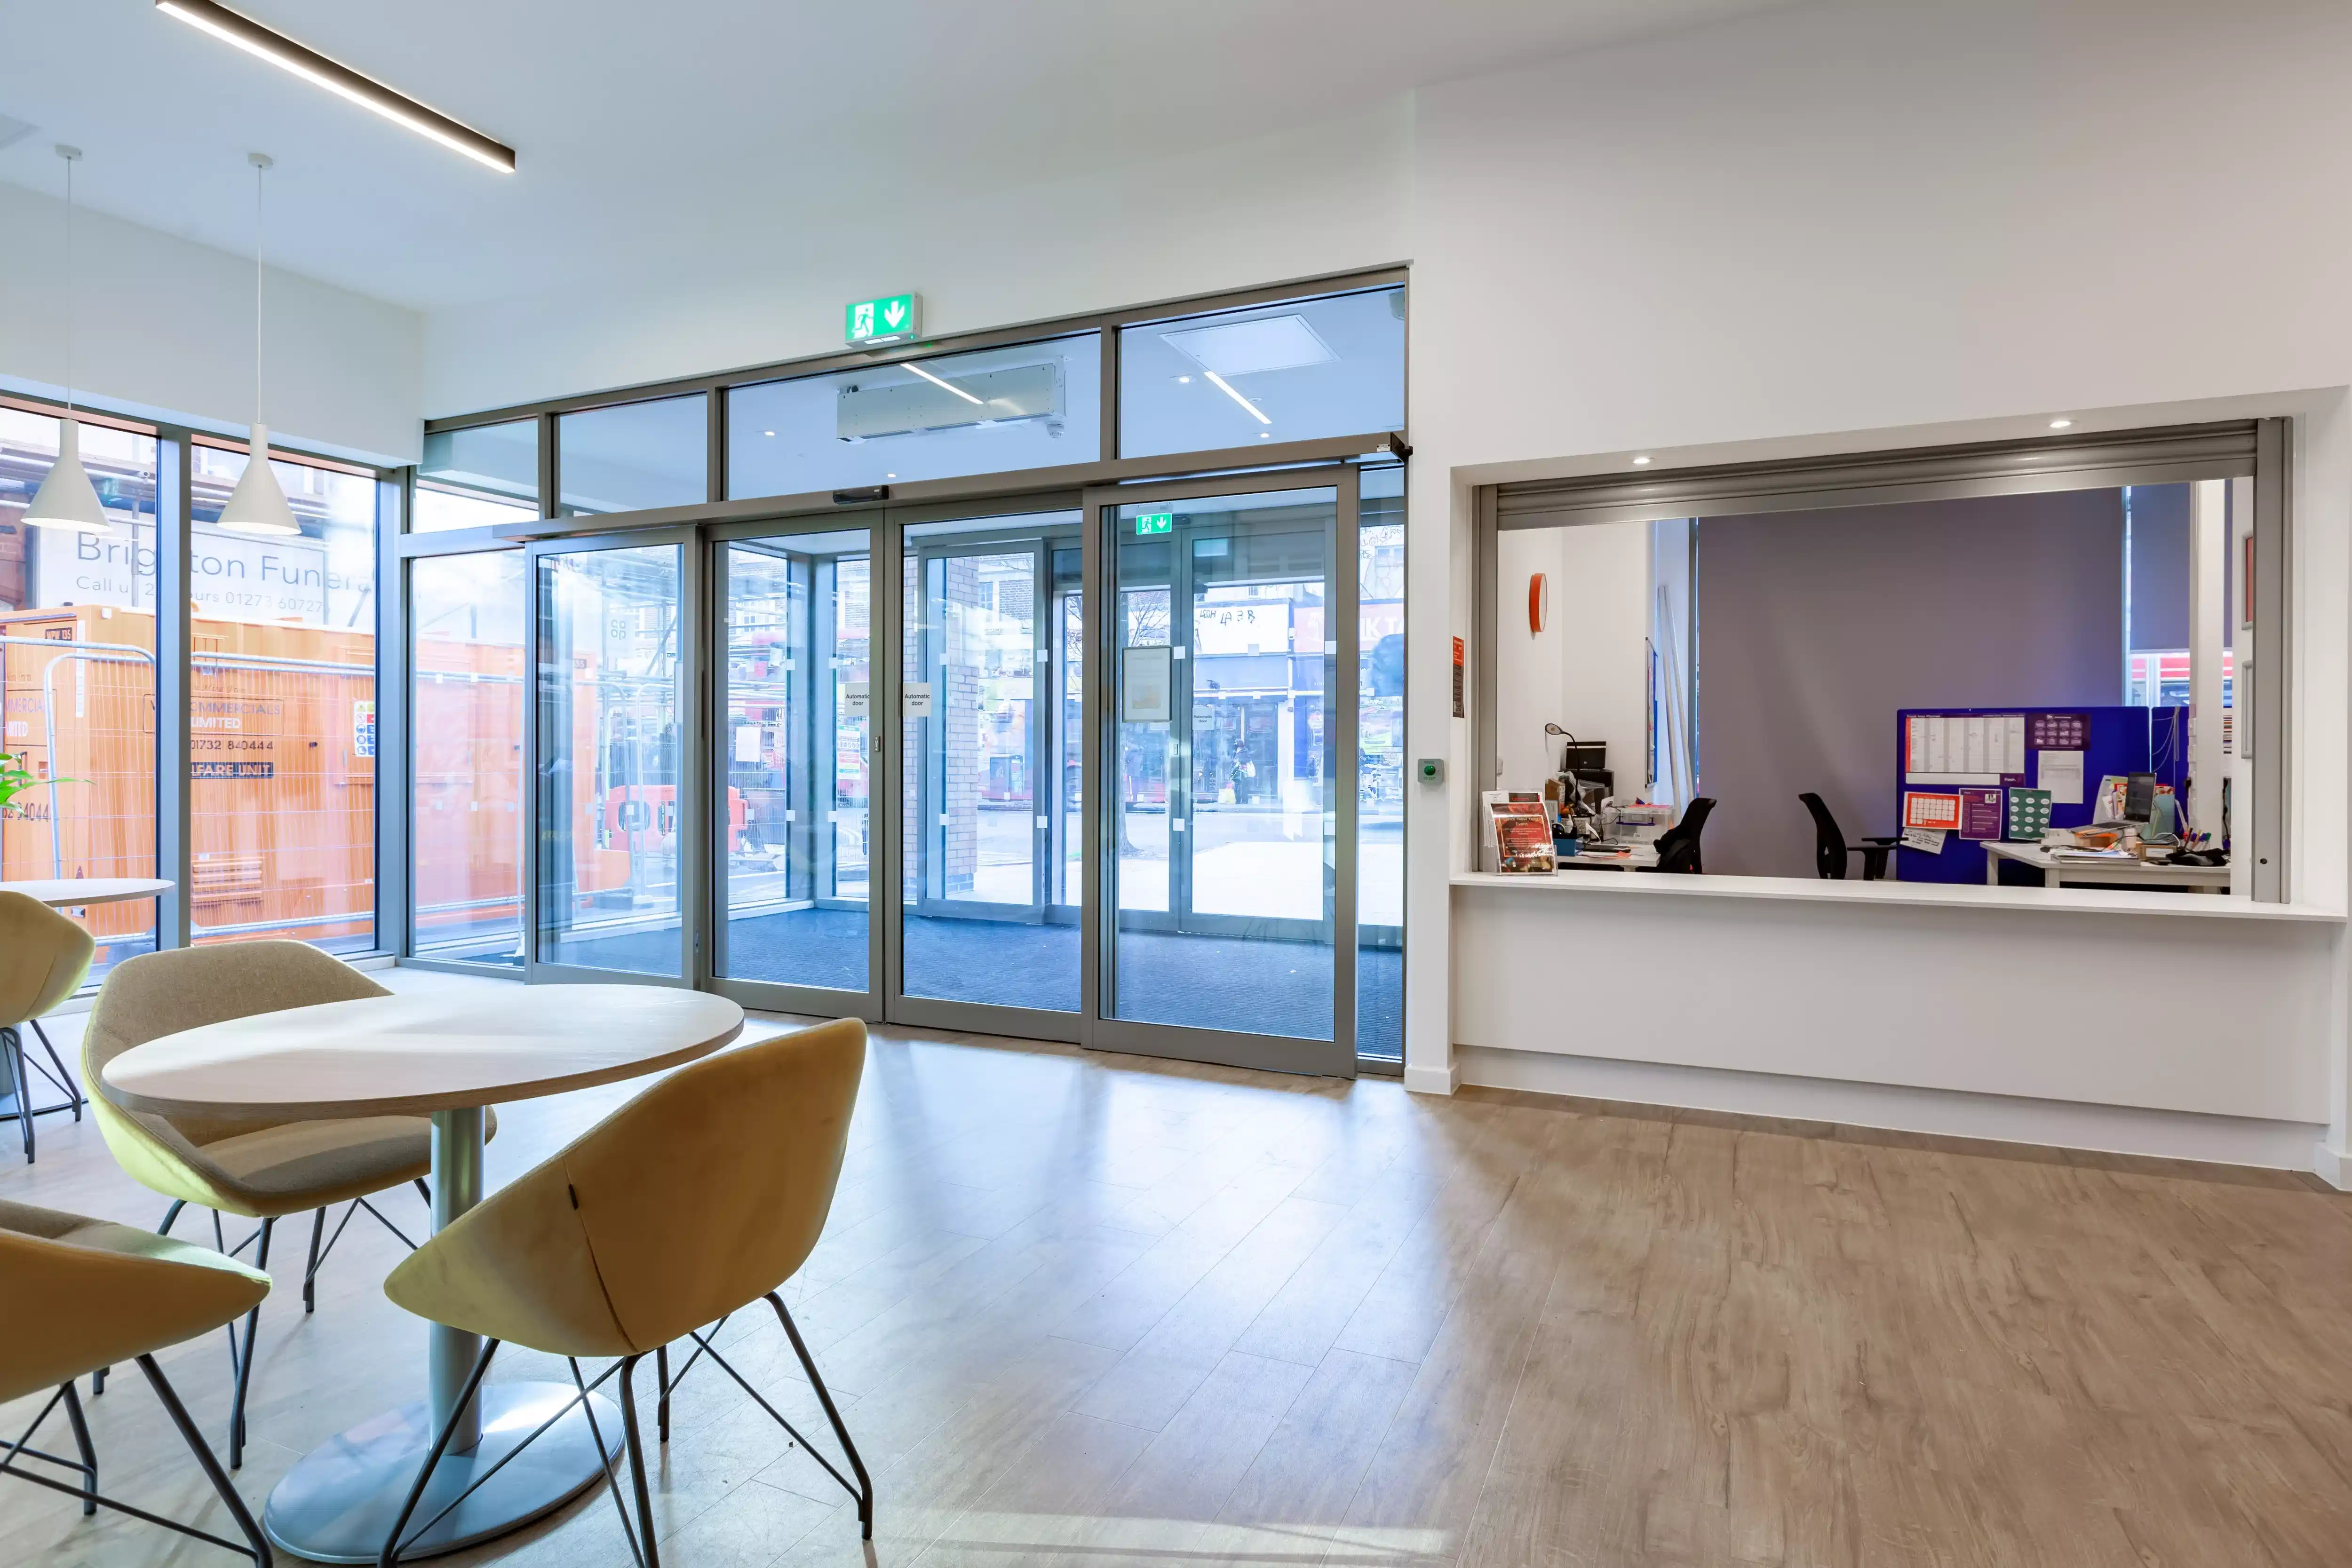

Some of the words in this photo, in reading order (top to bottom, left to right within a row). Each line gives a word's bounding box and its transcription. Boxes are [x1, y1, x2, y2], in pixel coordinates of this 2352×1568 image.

[77, 531, 245, 578] Brigton
[262, 555, 375, 594] Funera
[76, 576, 111, 592] Call
[190, 591, 219, 602] urs
[278, 598, 323, 612] 60727
[191, 702, 281, 715] OMMERCIALS
[191, 717, 241, 729] LIMITED
[191, 764, 234, 777] LFARE
[238, 765, 270, 777] UNIT
